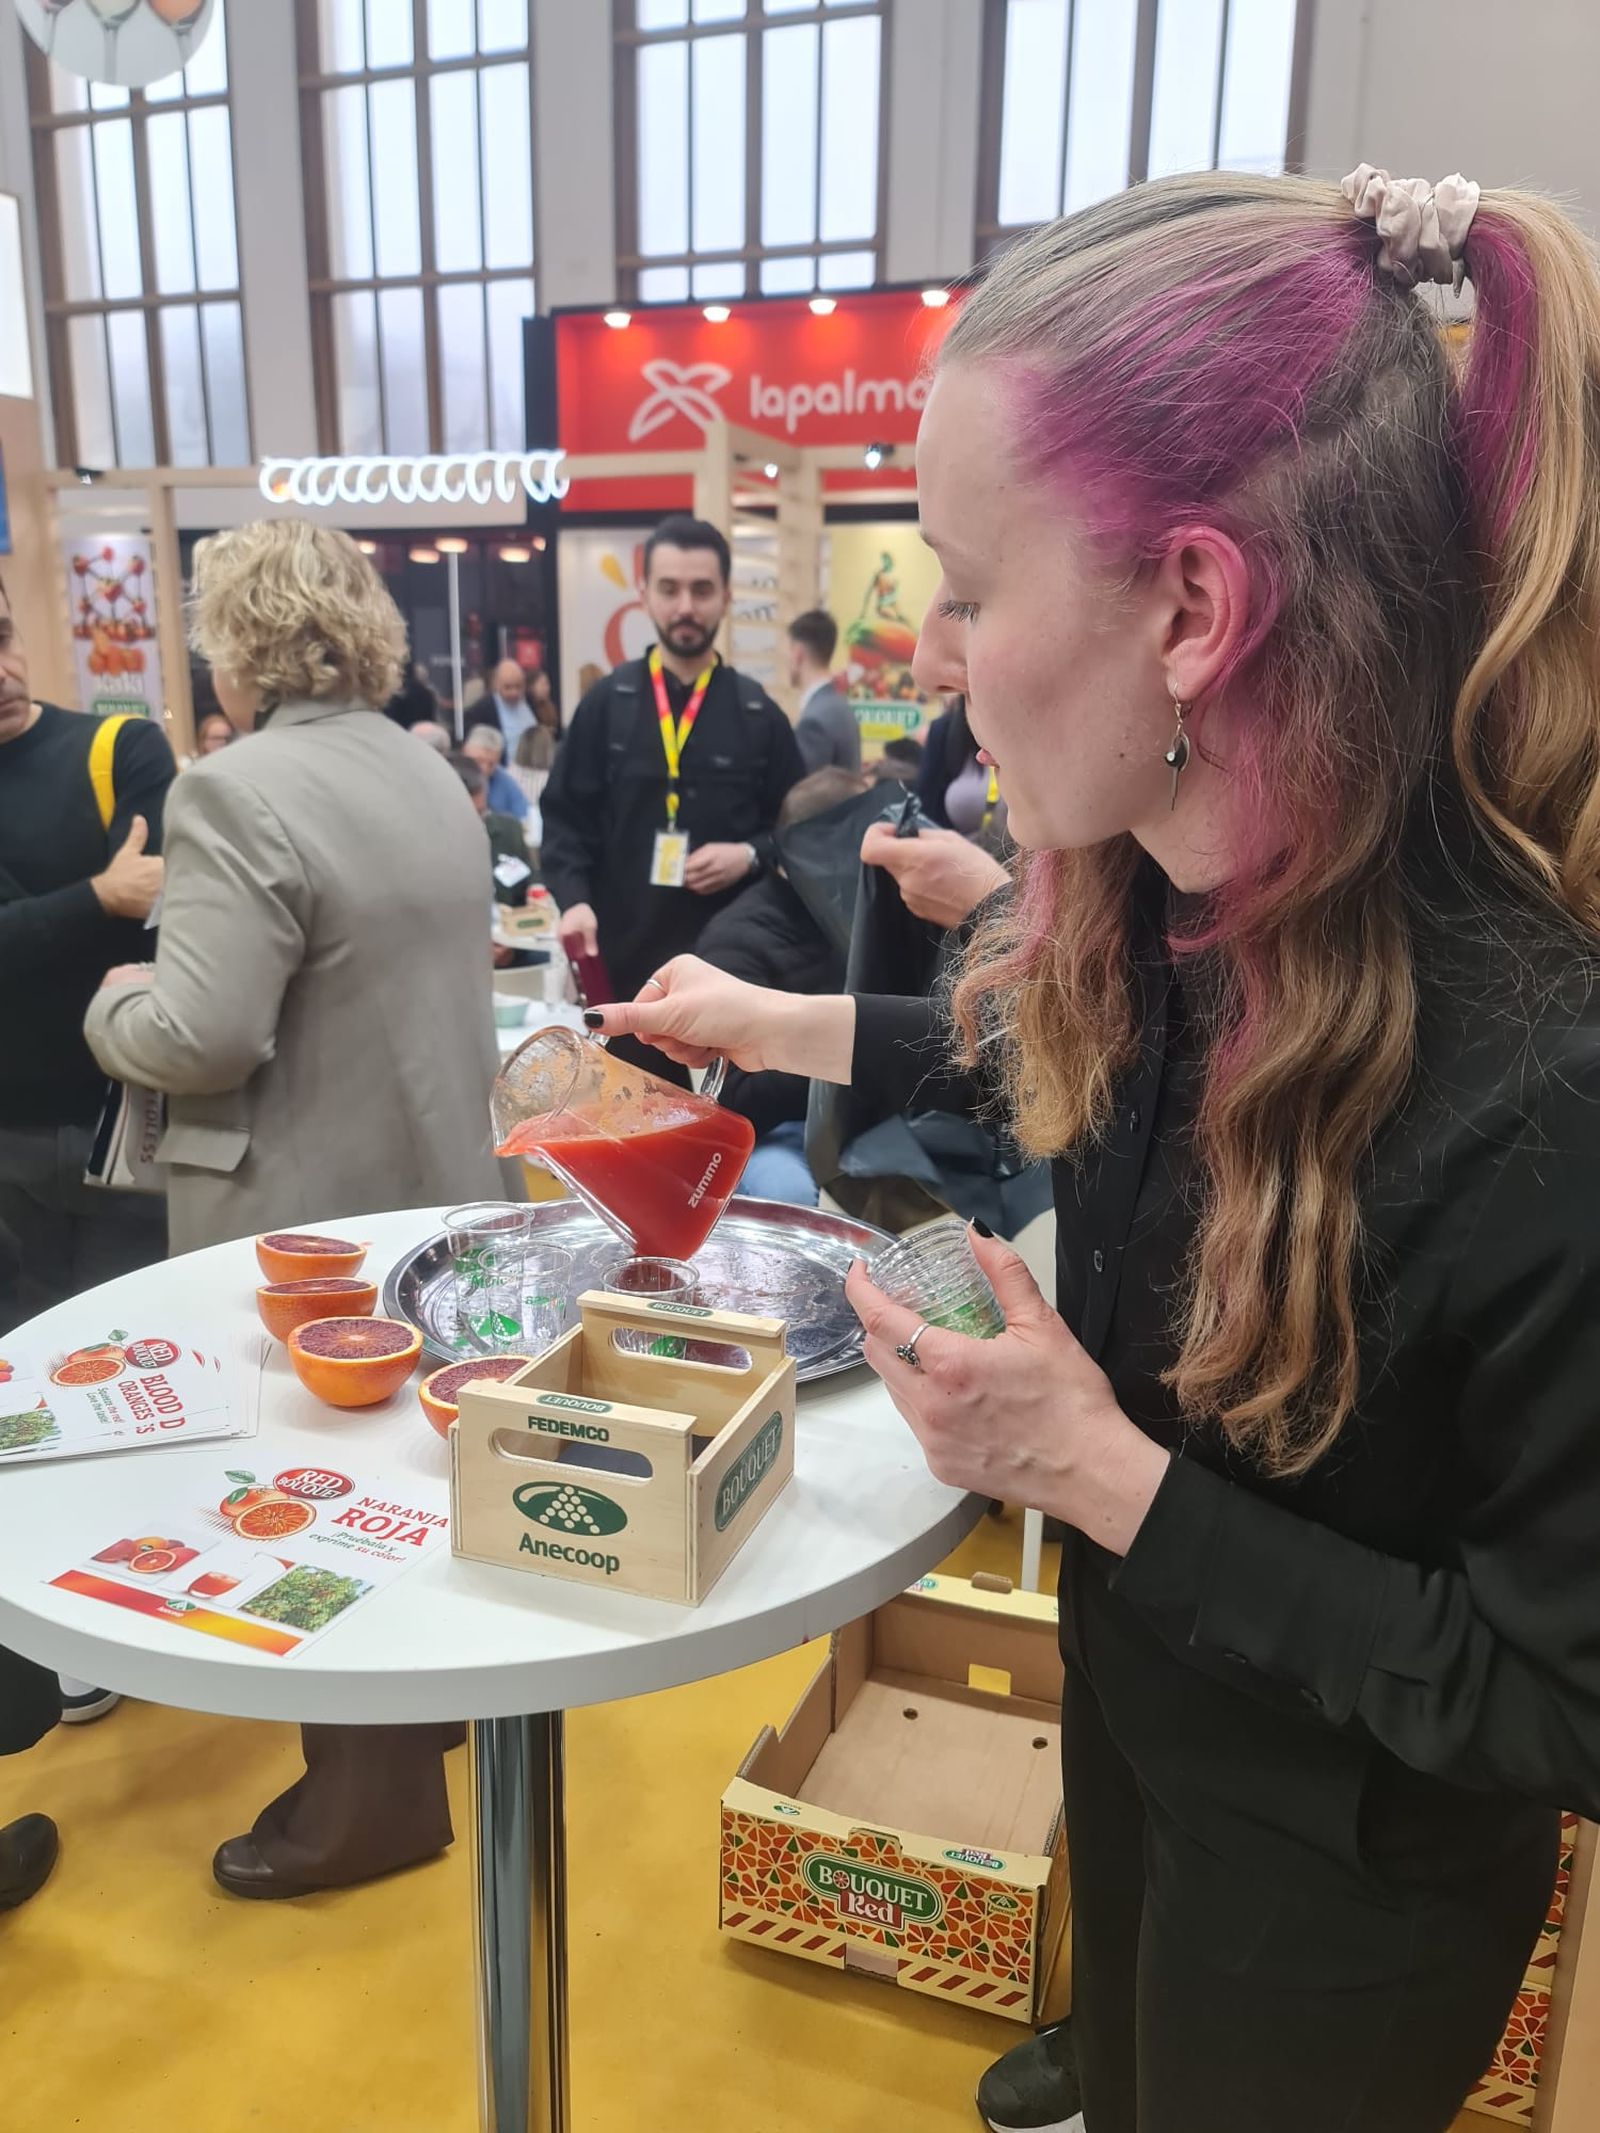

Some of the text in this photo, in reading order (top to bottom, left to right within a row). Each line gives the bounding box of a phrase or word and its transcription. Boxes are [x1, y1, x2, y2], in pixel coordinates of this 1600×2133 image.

[687, 1152, 722, 1208] zummo
[652, 1302, 709, 1316] BOUQUET
[142, 1342, 174, 1363] RED
[117, 1380, 156, 1421] ORANGES
[139, 1374, 184, 1414] BLOOD
[541, 1395, 607, 1412] BOUQUET
[136, 1422, 157, 1434] S
[528, 1415, 610, 1442] FEDEMCO
[295, 1470, 344, 1489] RED
[722, 1425, 778, 1516] BOUQUET
[277, 1476, 343, 1499] BOUQUET
[331, 1507, 431, 1546] ROJA
[356, 1497, 450, 1528] NARANJA
[308, 1533, 407, 1563] exprime su color!
[519, 1532, 621, 1575] Anecoop
[950, 1851, 1000, 1869] BOUQUET
[819, 1864, 928, 1911] BOUQUET
[847, 1892, 895, 1924] Red
